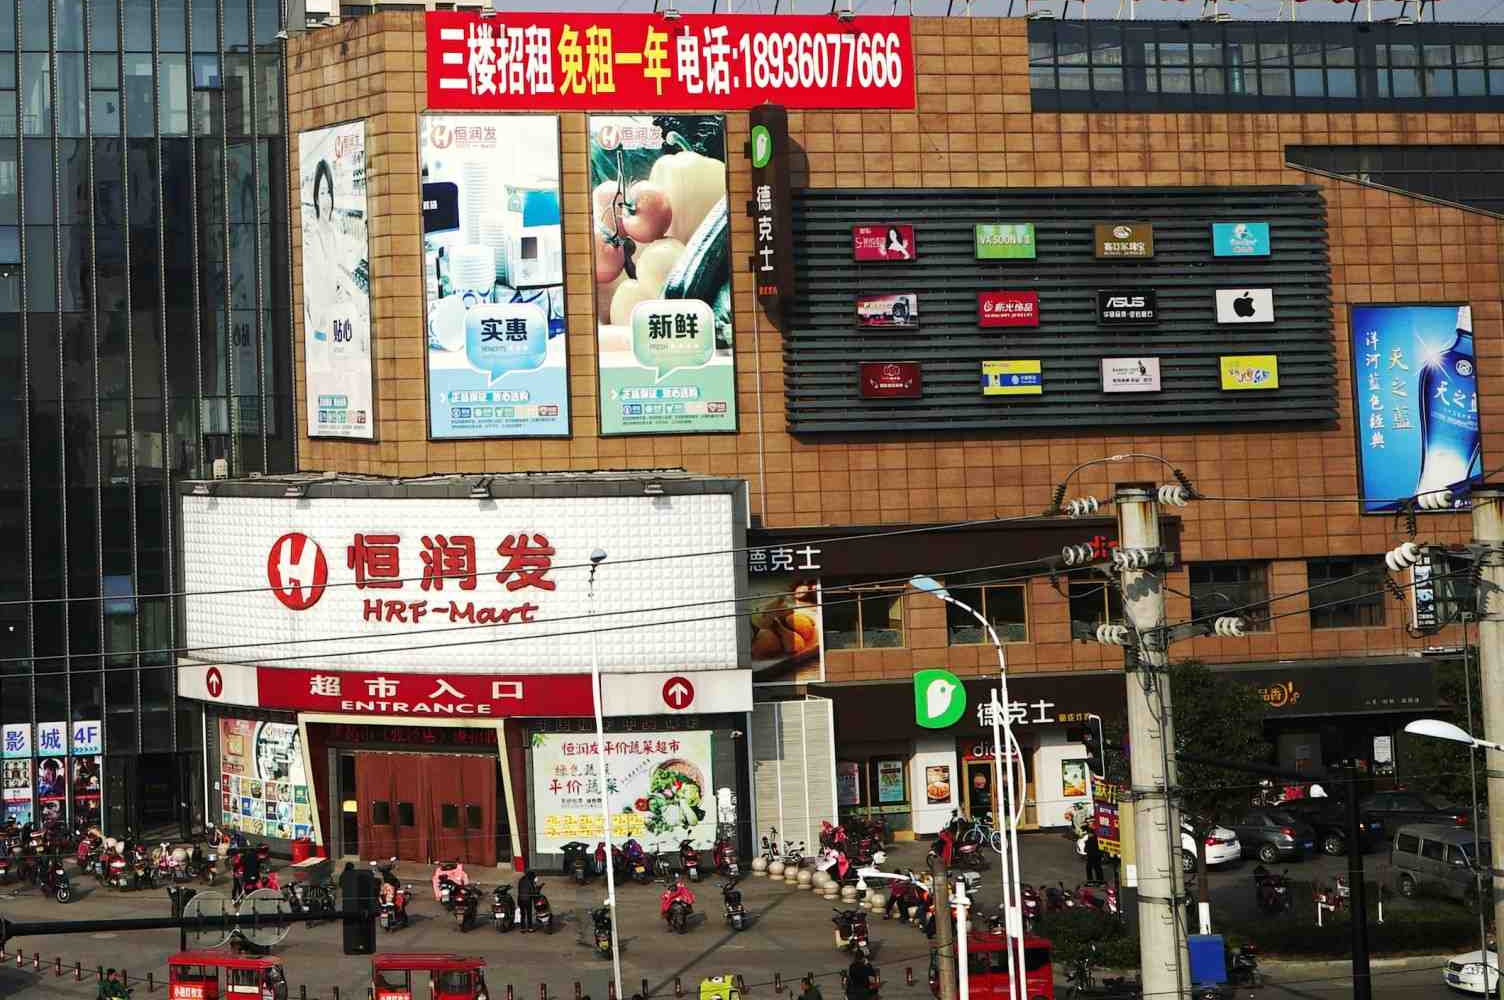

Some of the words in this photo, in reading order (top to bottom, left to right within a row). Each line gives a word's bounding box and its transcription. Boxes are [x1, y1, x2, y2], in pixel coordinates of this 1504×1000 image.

[439, 23, 555, 95] 三楼招租
[558, 24, 671, 95] 免租一年
[677, 24, 903, 95] 电话:18936077666
[757, 185, 774, 271] 德克士
[1106, 297, 1145, 308] ASUS
[480, 318, 528, 342] 实惠
[648, 313, 700, 339] 新鲜
[347, 534, 556, 592] 恒润发
[363, 599, 539, 624] HRF-Mart
[310, 674, 524, 700] 超市入口
[341, 700, 491, 714] ENTRANCE
[977, 700, 1055, 727] 德克士
[74, 727, 98, 744] 4F
